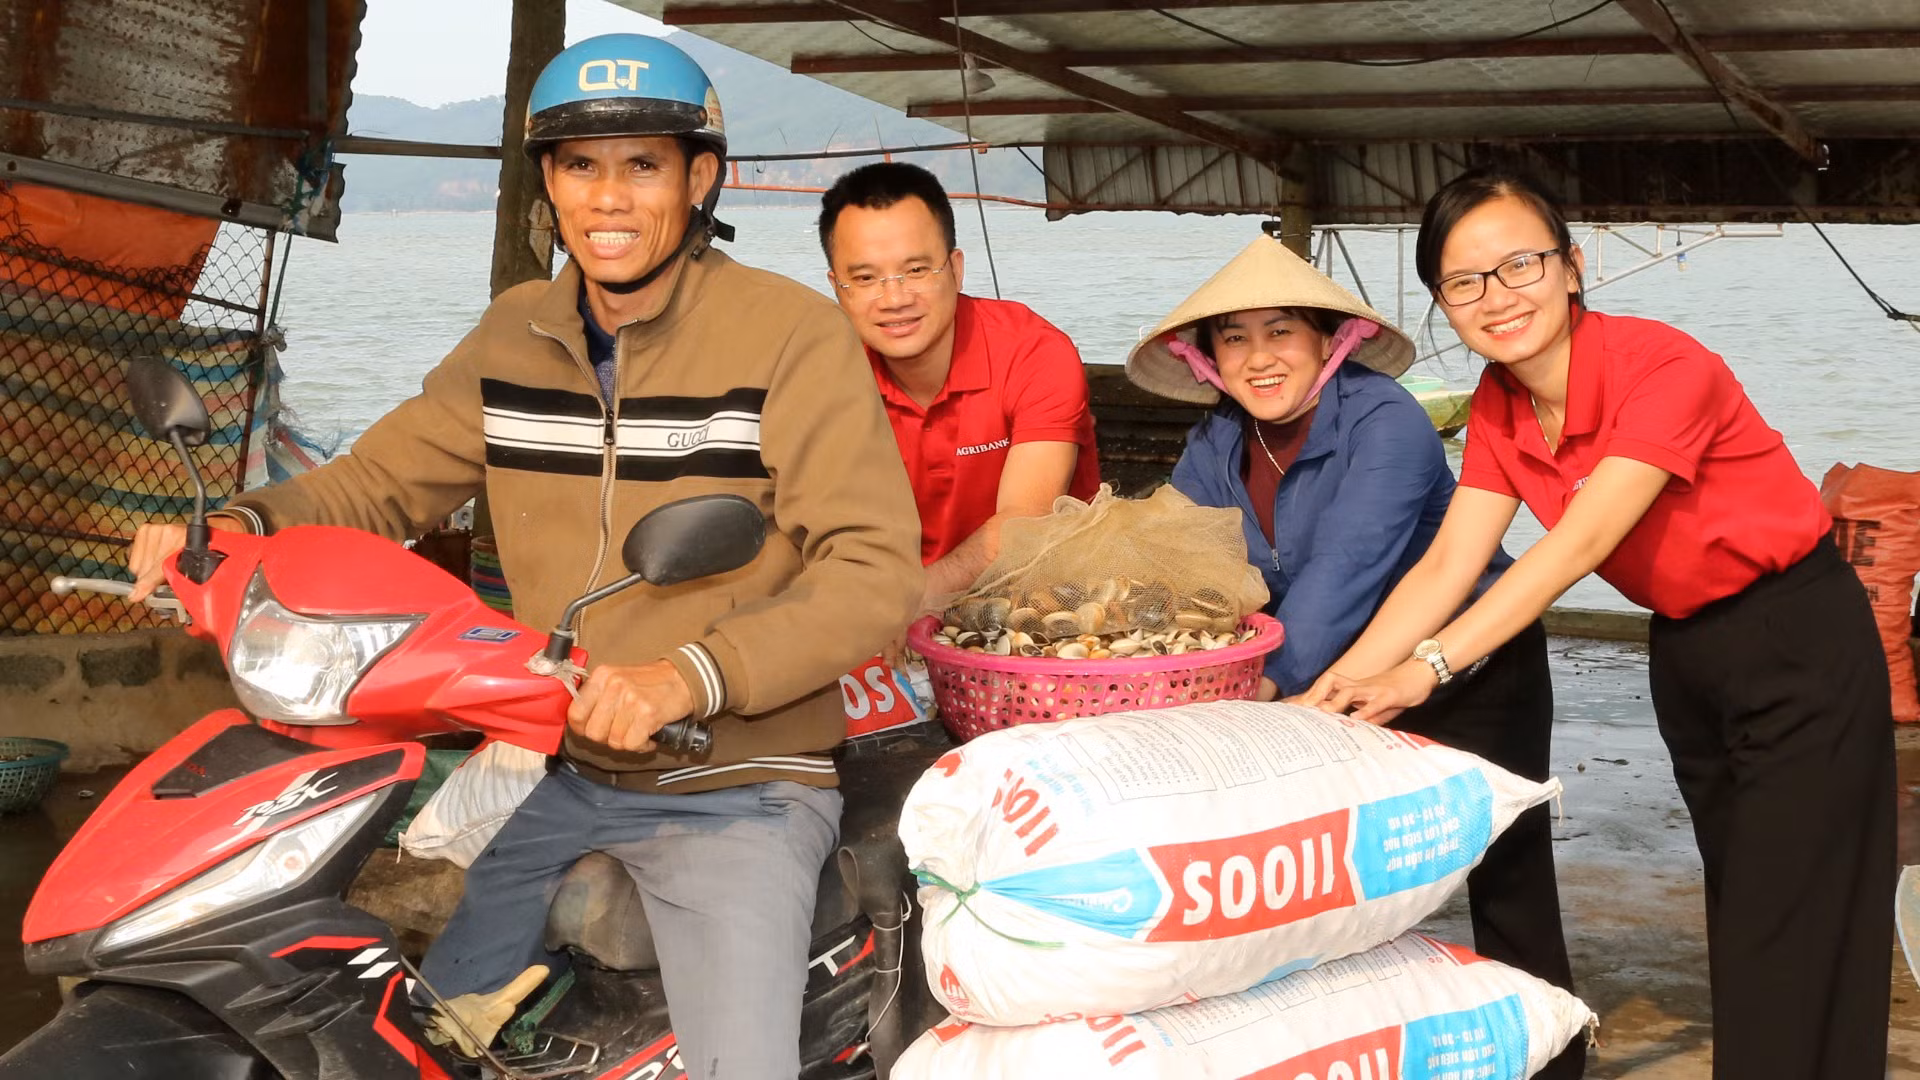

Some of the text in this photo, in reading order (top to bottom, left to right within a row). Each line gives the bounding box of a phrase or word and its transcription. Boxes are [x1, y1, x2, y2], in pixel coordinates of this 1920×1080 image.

[578, 59, 650, 92] QT
[667, 426, 710, 448] GUCCI
[955, 437, 1010, 456] AGRIBANK
